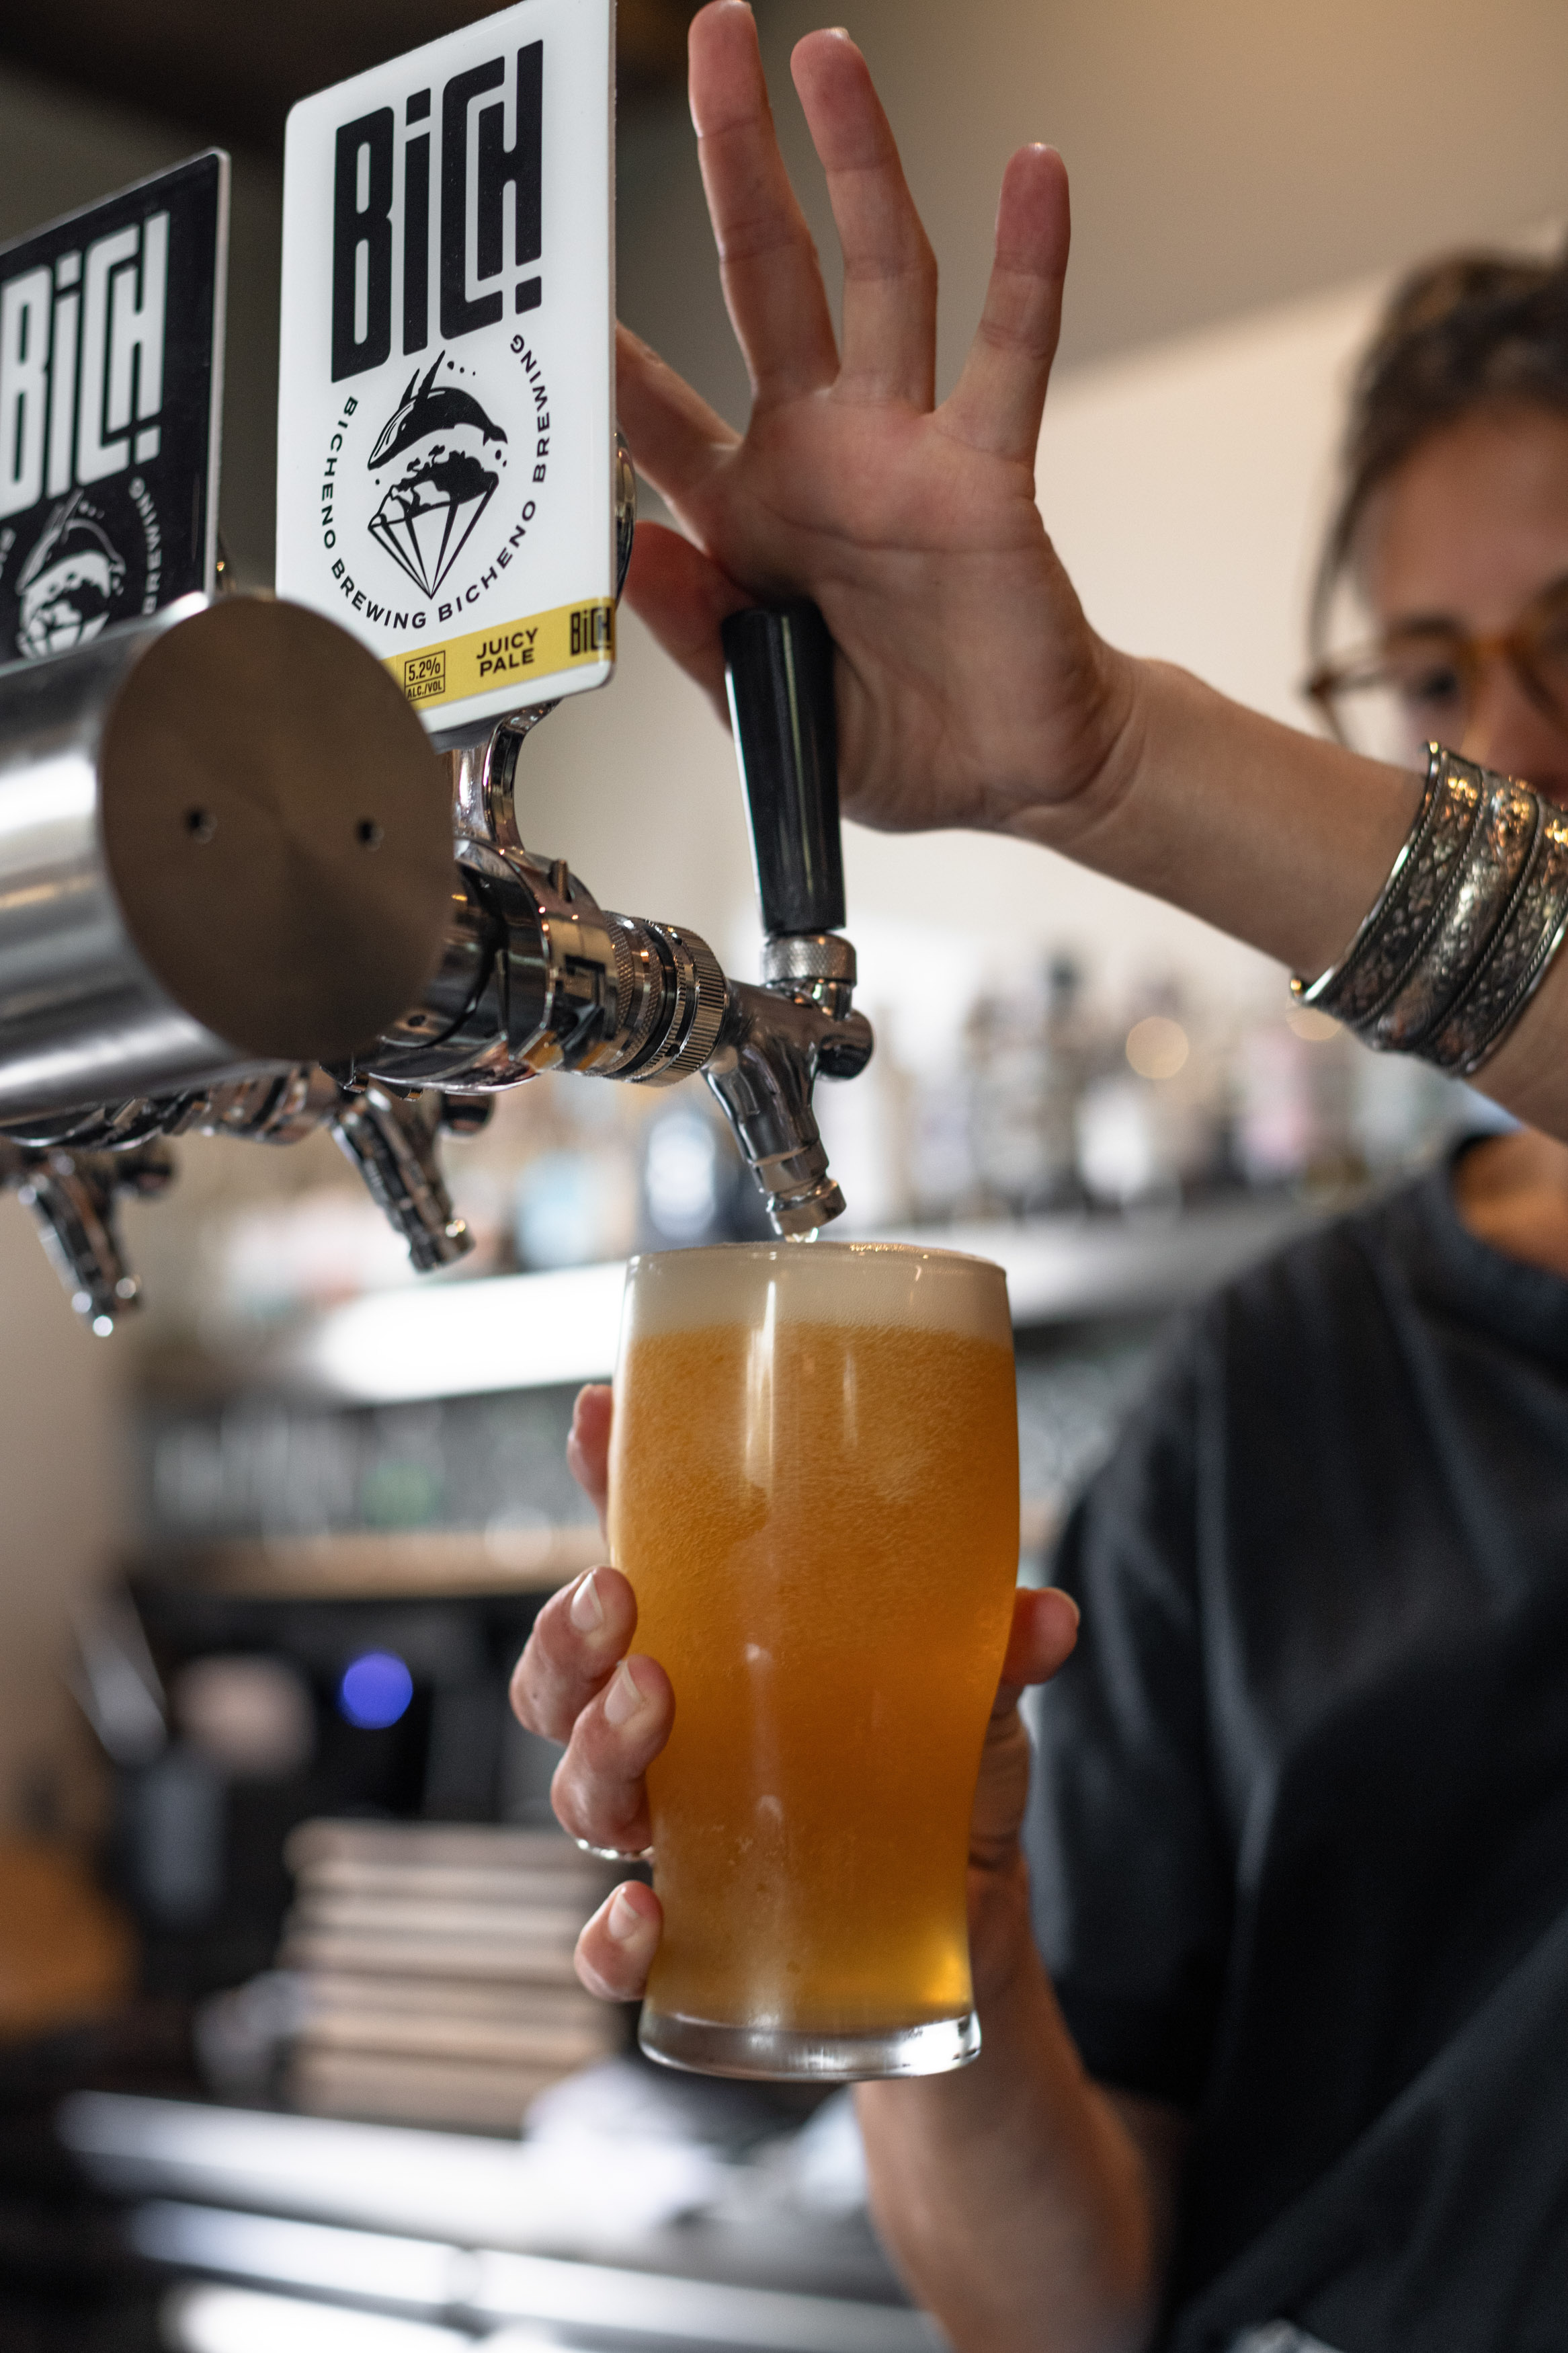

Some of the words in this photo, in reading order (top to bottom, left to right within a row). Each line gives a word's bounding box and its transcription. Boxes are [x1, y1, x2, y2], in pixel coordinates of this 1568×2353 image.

[510, 334, 550, 483] BREWING
[321, 396, 358, 549] BICHENO
[331, 558, 427, 629] BREWING
[439, 500, 536, 623] BICHENO
[408, 657, 441, 682] 5.2%
[477, 627, 538, 660] JUICY
[480, 647, 535, 678] PALE
